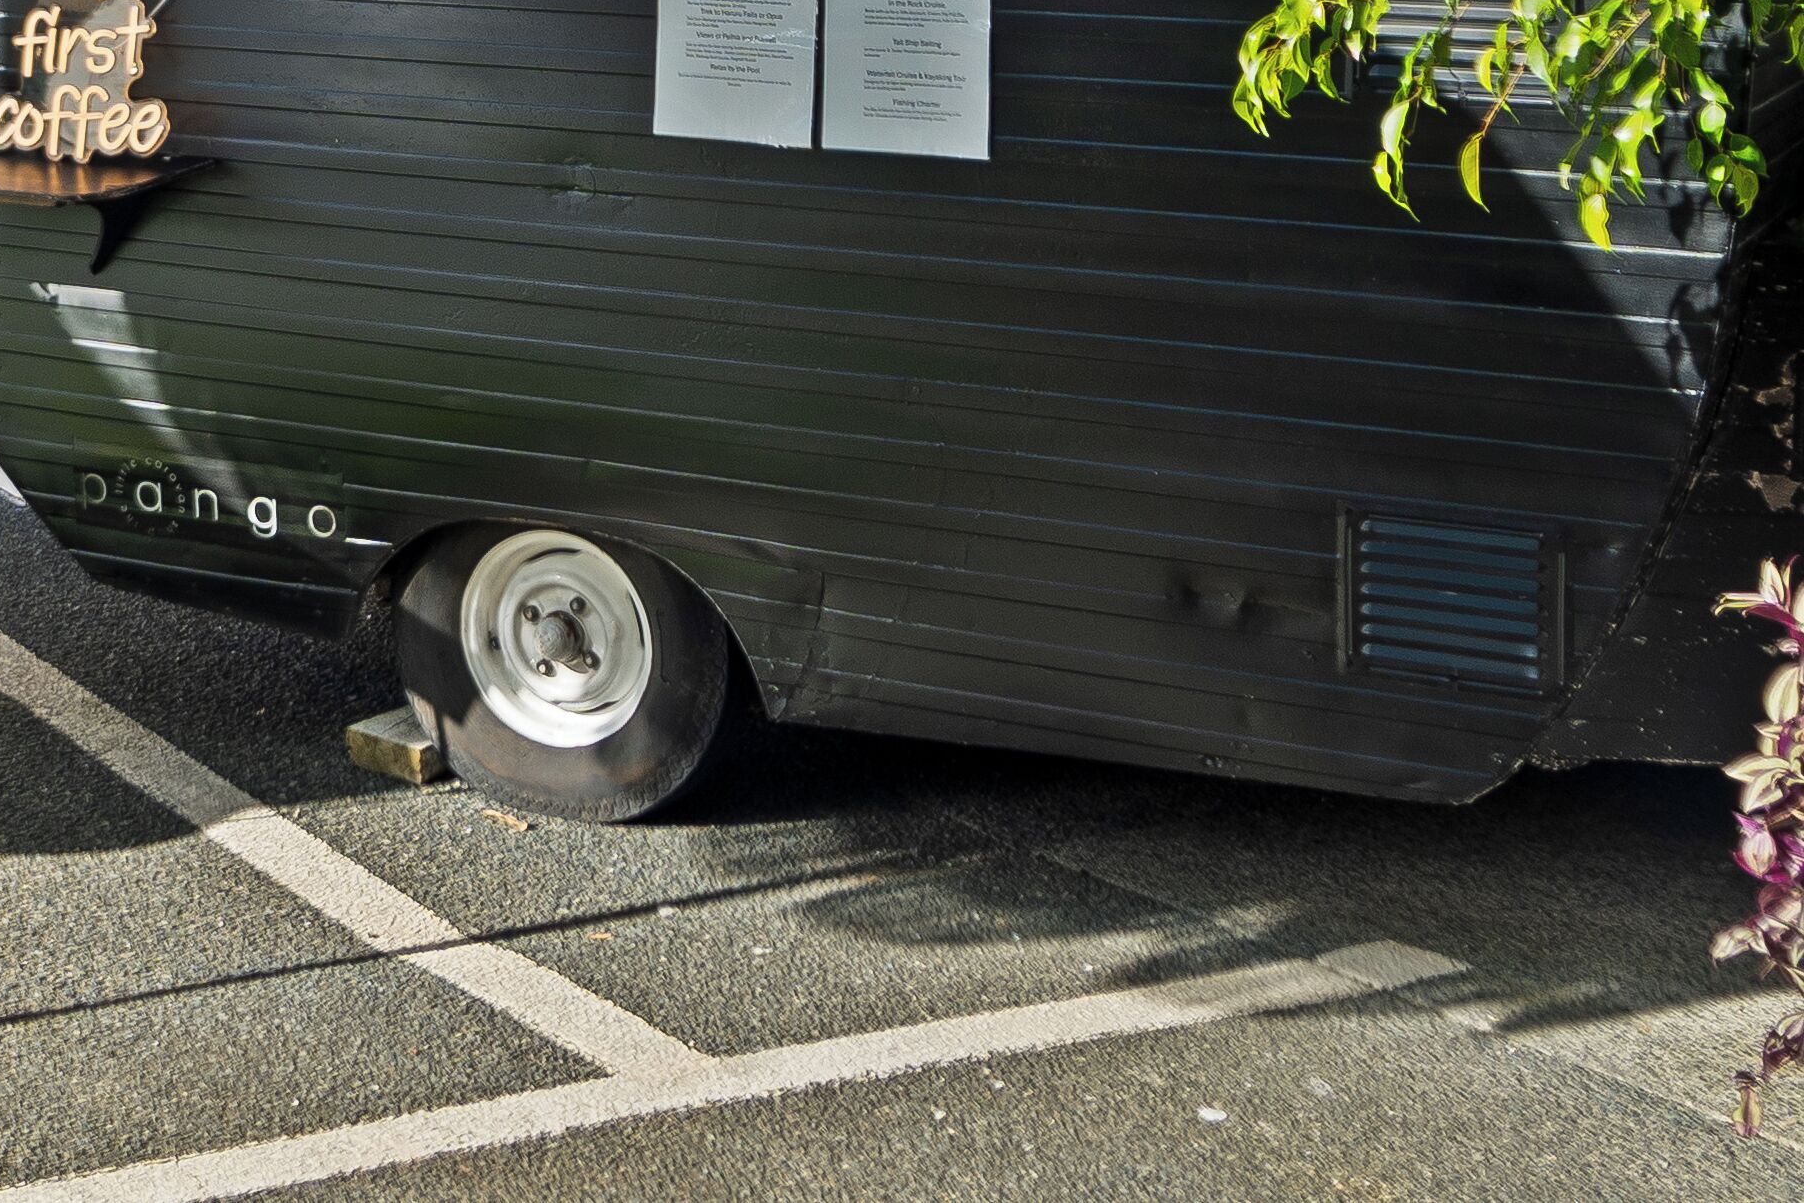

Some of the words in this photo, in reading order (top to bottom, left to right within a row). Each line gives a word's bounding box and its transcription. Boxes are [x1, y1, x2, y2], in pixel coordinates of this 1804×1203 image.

[12, 4, 152, 77] first
[736, 64, 746, 72] the
[747, 66, 760, 74] Pool
[82, 472, 337, 538] pango
